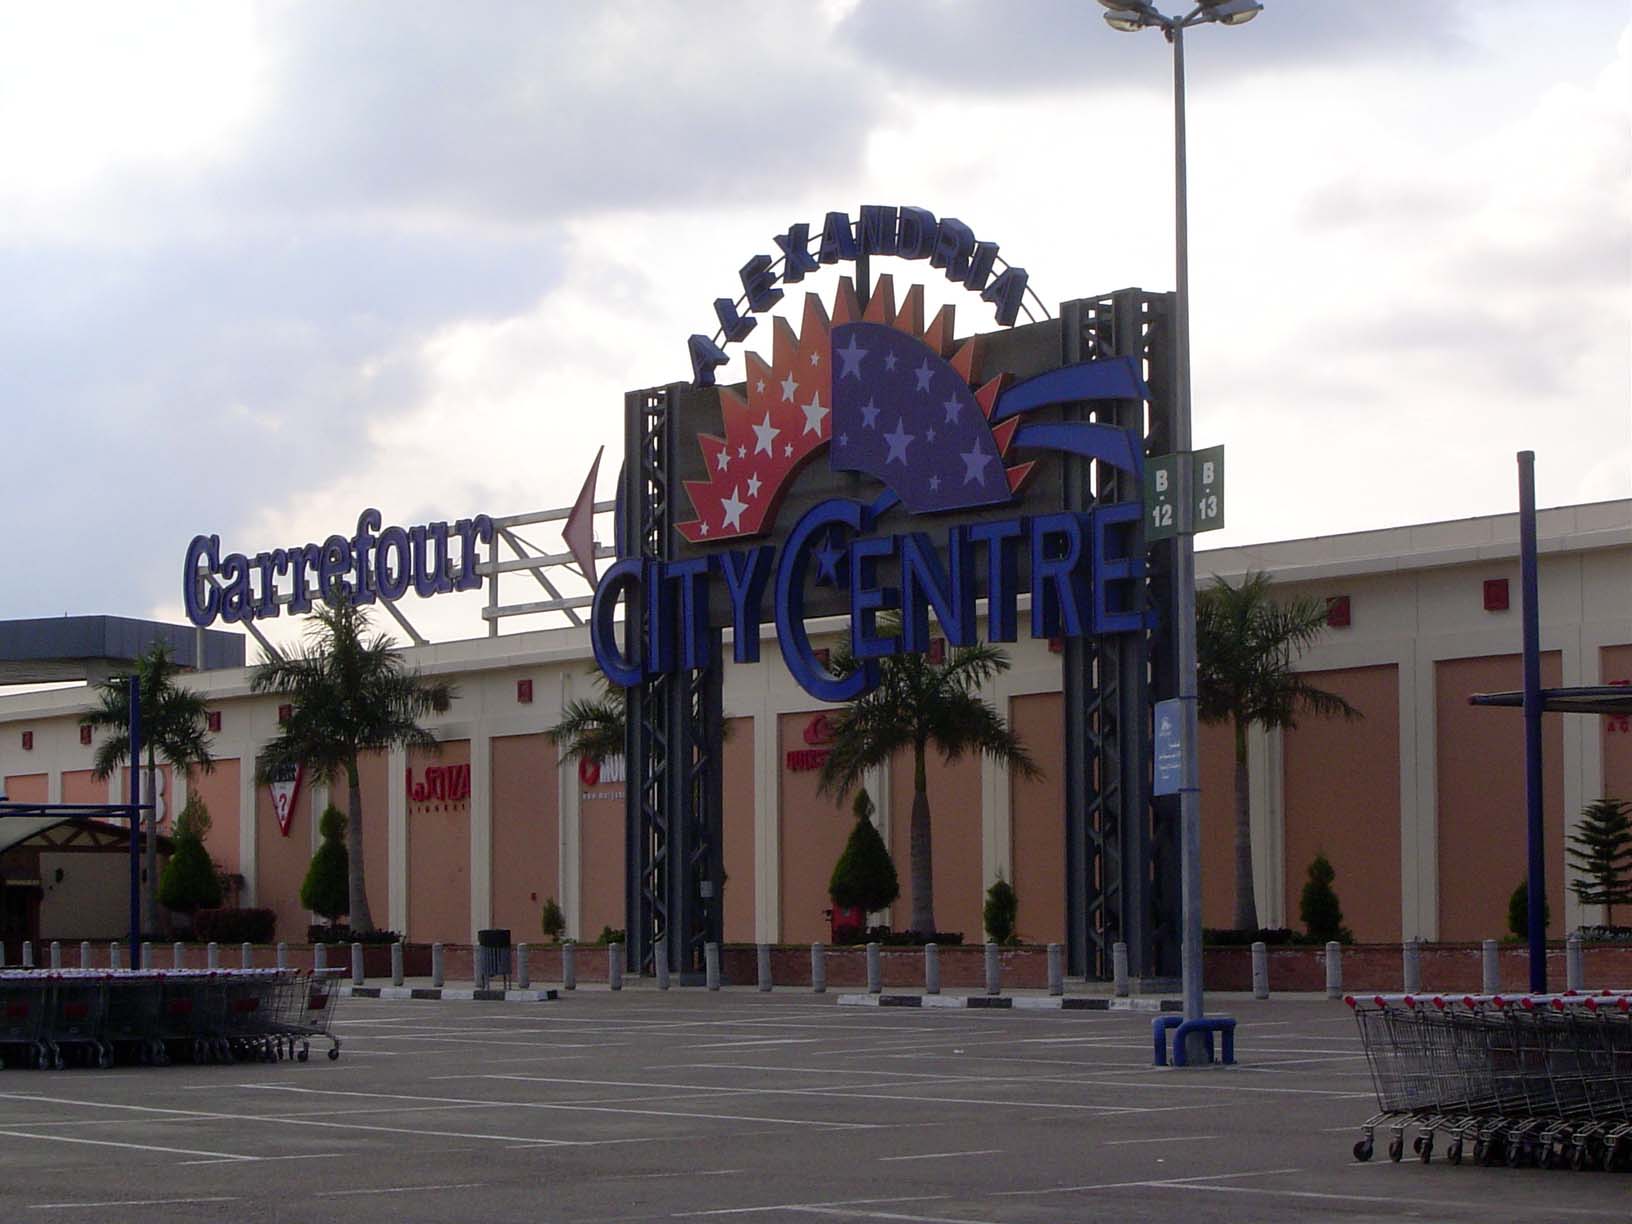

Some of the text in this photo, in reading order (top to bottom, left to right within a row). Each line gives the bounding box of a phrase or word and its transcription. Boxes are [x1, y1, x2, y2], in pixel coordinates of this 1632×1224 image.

[687, 204, 1029, 388] ALEXANDRIA
[1155, 469, 1168, 493] B
[1203, 461, 1215, 485] B
[1152, 504, 1173, 528] 12
[1199, 495, 1217, 520] 13
[183, 508, 493, 628] Carrefour
